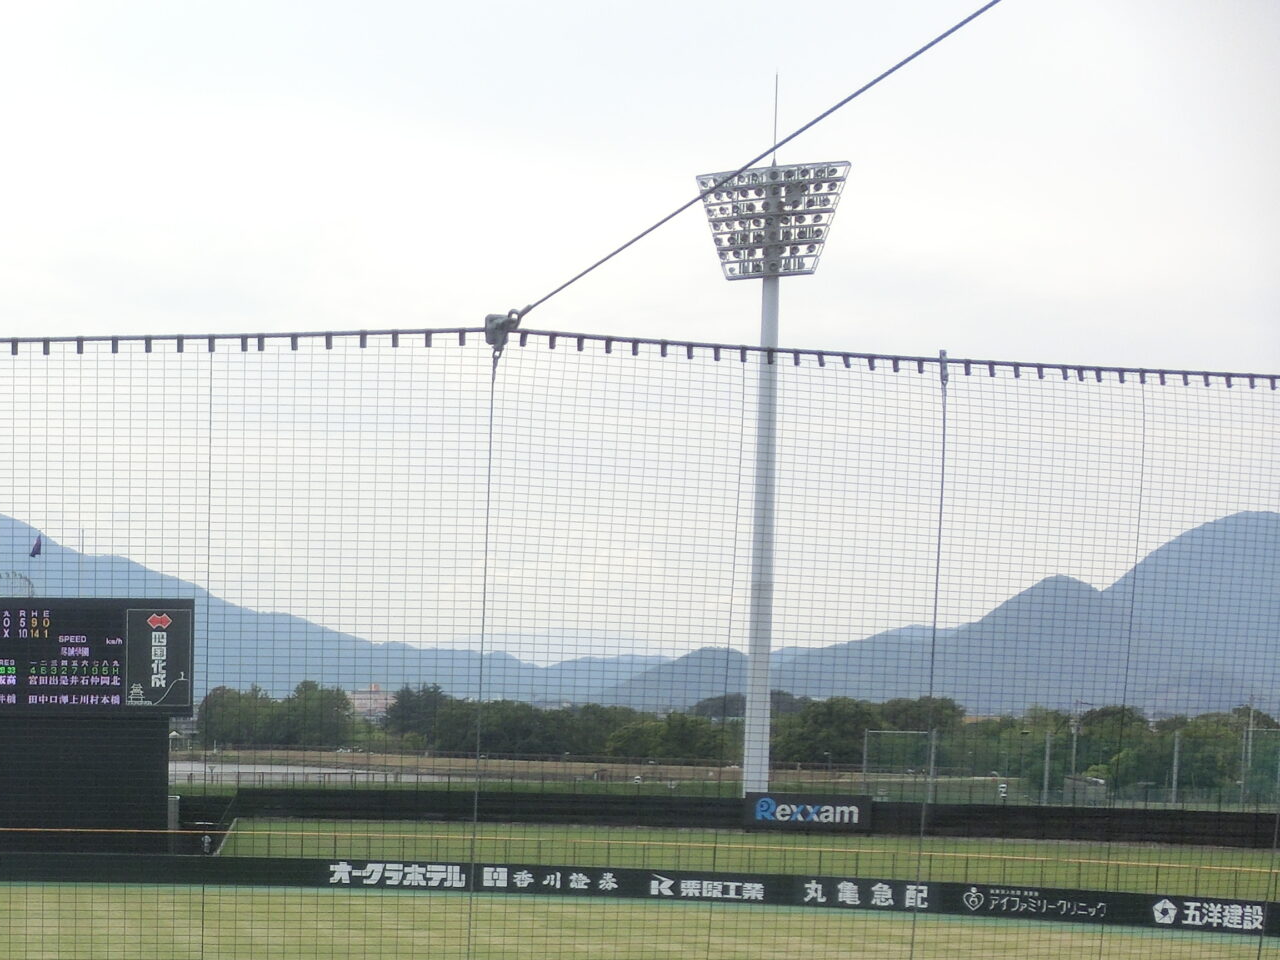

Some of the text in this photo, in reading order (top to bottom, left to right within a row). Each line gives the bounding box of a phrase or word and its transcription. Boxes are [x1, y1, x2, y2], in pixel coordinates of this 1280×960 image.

[151, 632, 167, 688] 四国化成
[755, 796, 859, 824] Rexxam
[329, 862, 466, 888] オークラホテル
[804, 880, 929, 908] 丸亀急配
[989, 896, 1107, 918] アイファミリークリニック
[1182, 901, 1264, 930] 五洋建設
